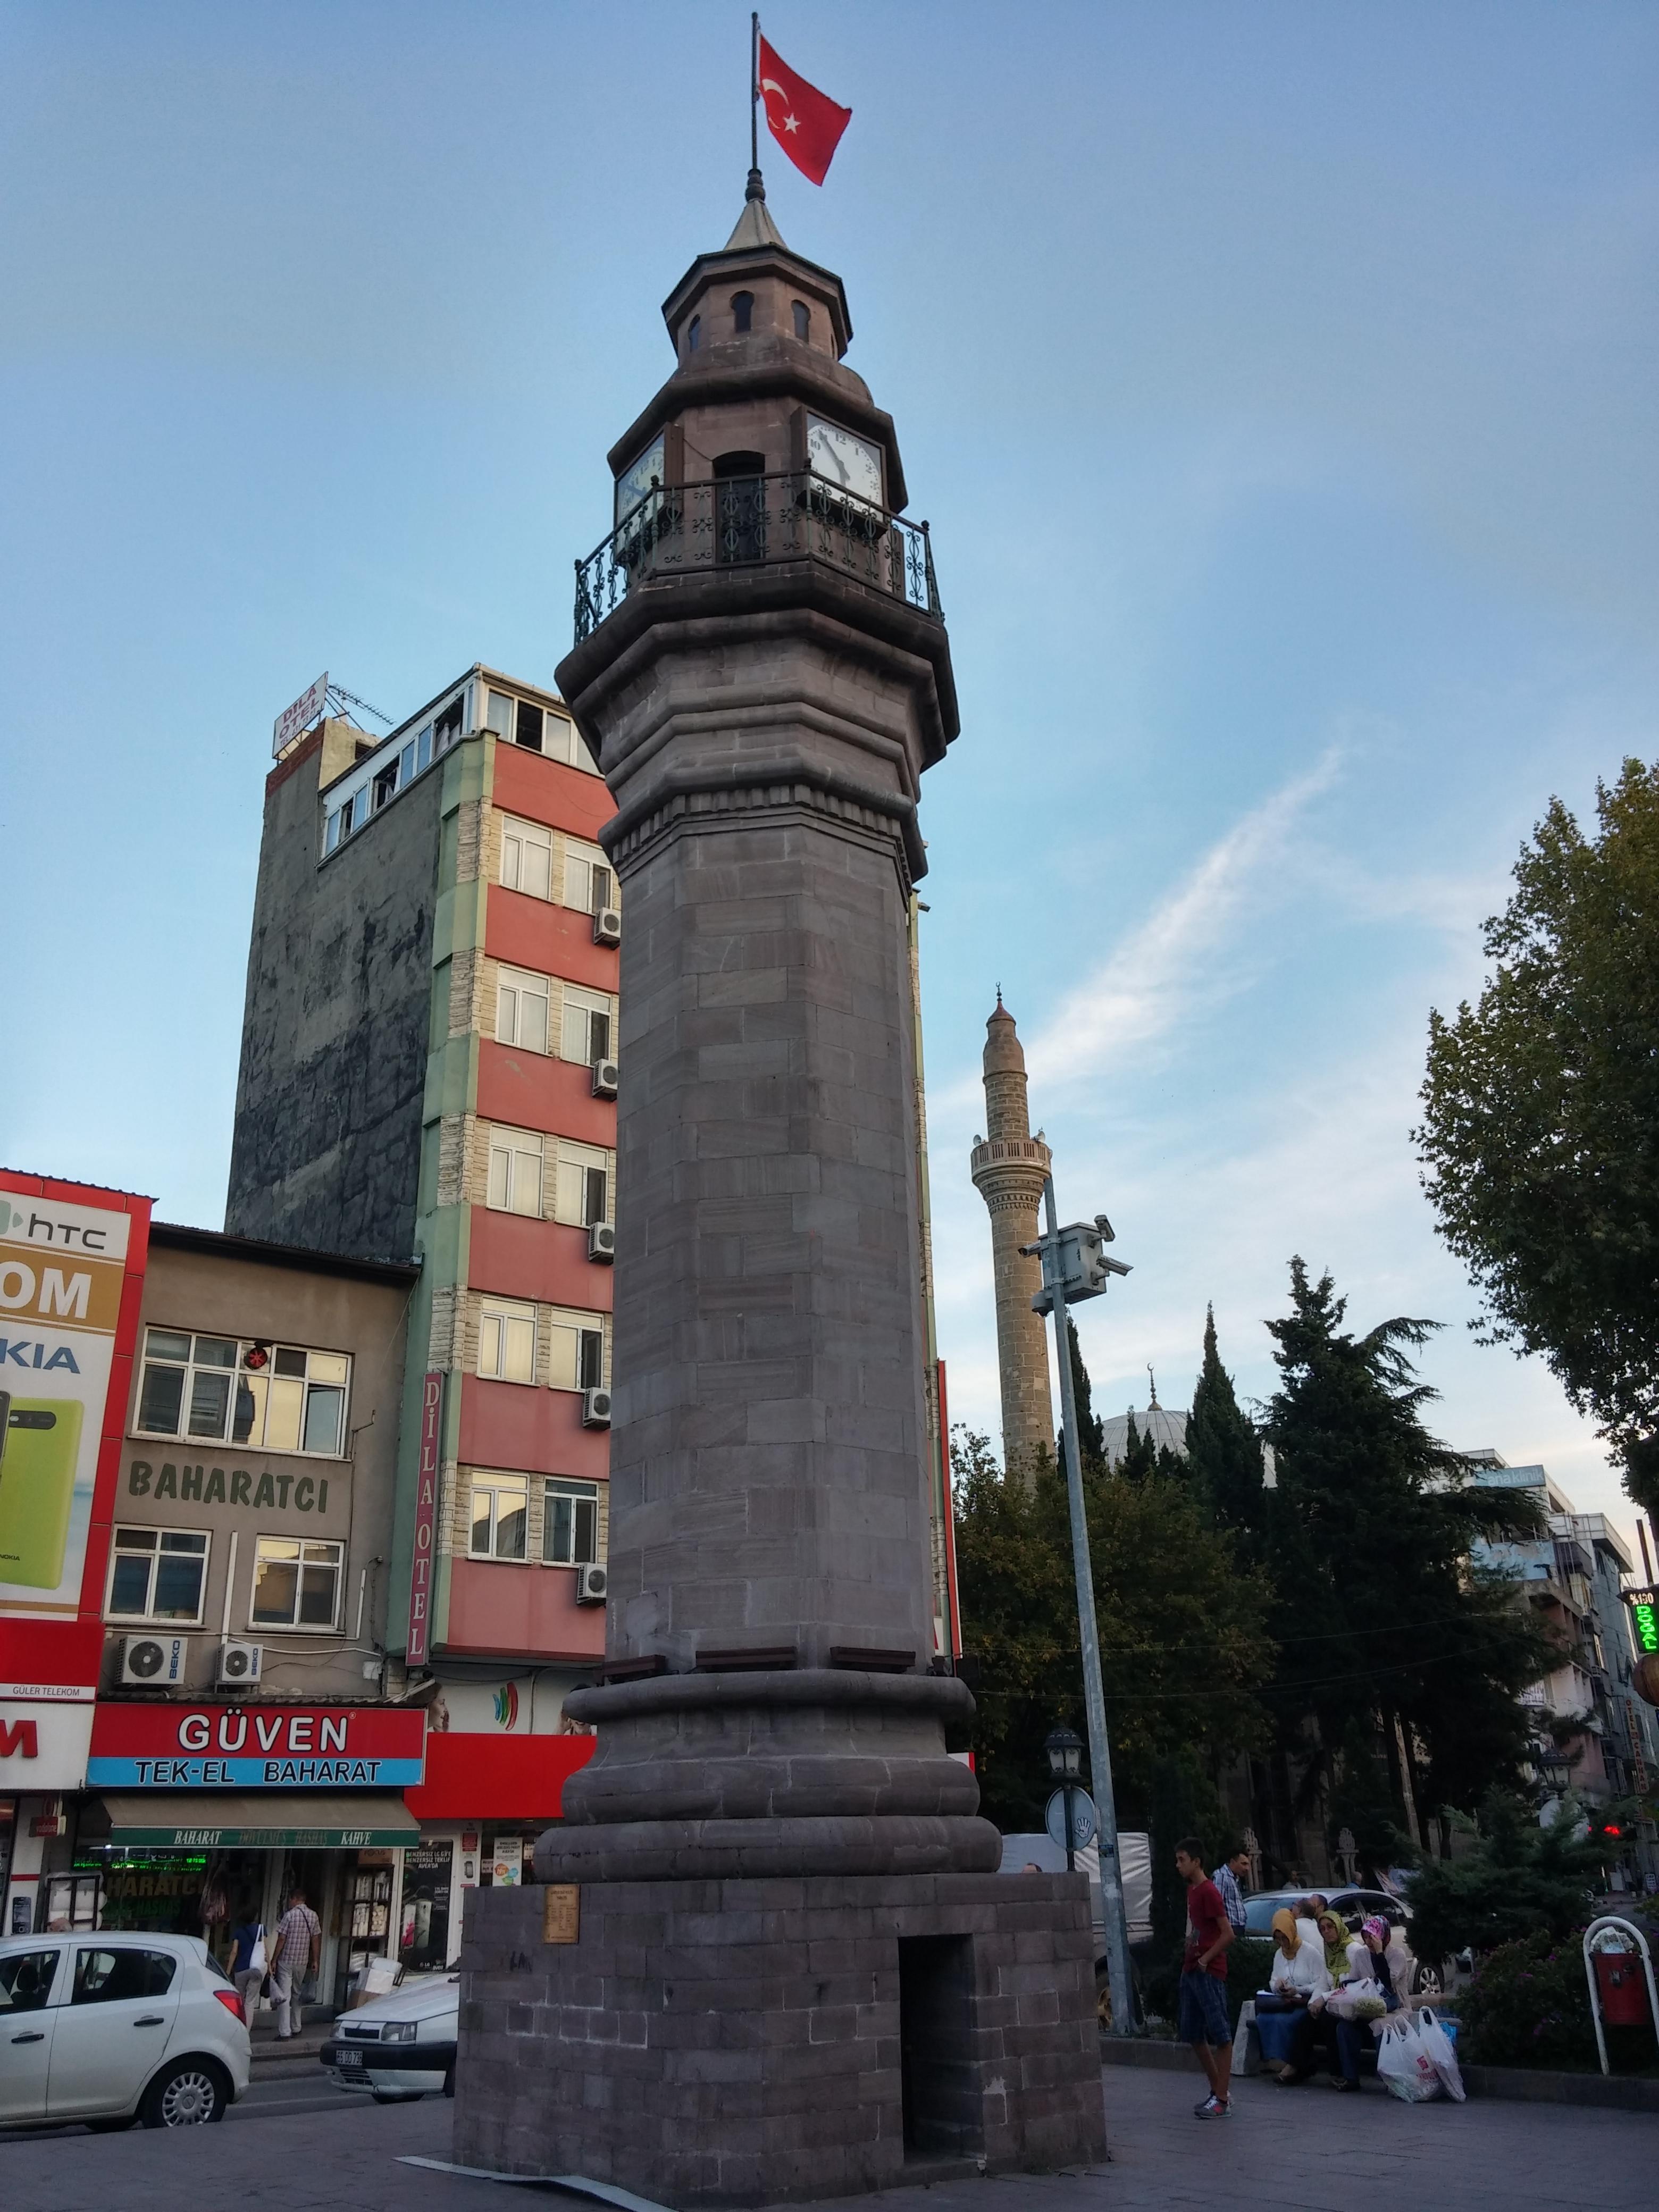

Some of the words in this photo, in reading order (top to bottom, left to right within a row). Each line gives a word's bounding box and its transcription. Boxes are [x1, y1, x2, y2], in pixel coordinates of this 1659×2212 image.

[279, 698, 320, 739] OTEL
[0, 1338, 81, 1375] KIA
[420, 1382, 439, 1505] DİLA
[129, 1461, 329, 1513] BAHARATCI
[1512, 1467, 1544, 1483] klinik
[410, 1522, 431, 1655] OTEL
[169, 1640, 181, 1679] BEKO
[13, 1685, 40, 1695] GÜLER
[42, 1687, 80, 1696] TELEKOM
[178, 1707, 348, 1752] GÜVEN
[1626, 1699, 1635, 1730] OTEL
[135, 1761, 235, 1783] TEK-EL
[263, 1761, 382, 1784] BAHARAT
[173, 1830, 222, 1845] BAHARAT
[340, 1831, 372, 1845] KAHVE
